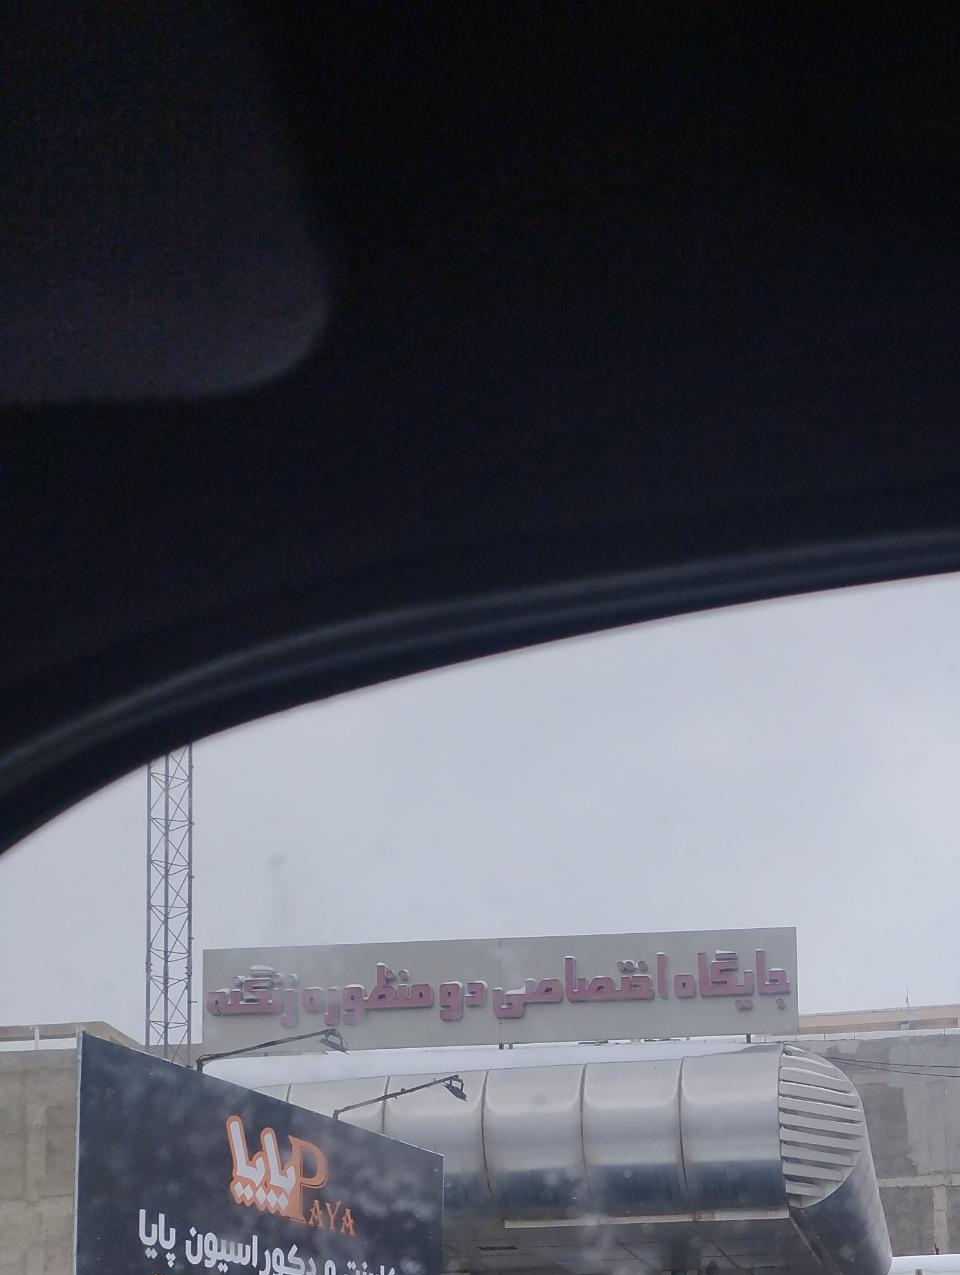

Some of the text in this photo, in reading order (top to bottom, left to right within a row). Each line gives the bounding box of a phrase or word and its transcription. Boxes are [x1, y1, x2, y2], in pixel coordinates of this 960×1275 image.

[302, 961, 436, 1027] منظوره
[439, 979, 488, 1022] دو
[492, 952, 670, 1019] اختصاصی
[673, 948, 793, 1011] جایگاه
[226, 1115, 297, 1214] پایا
[138, 1208, 176, 1268] پایا
